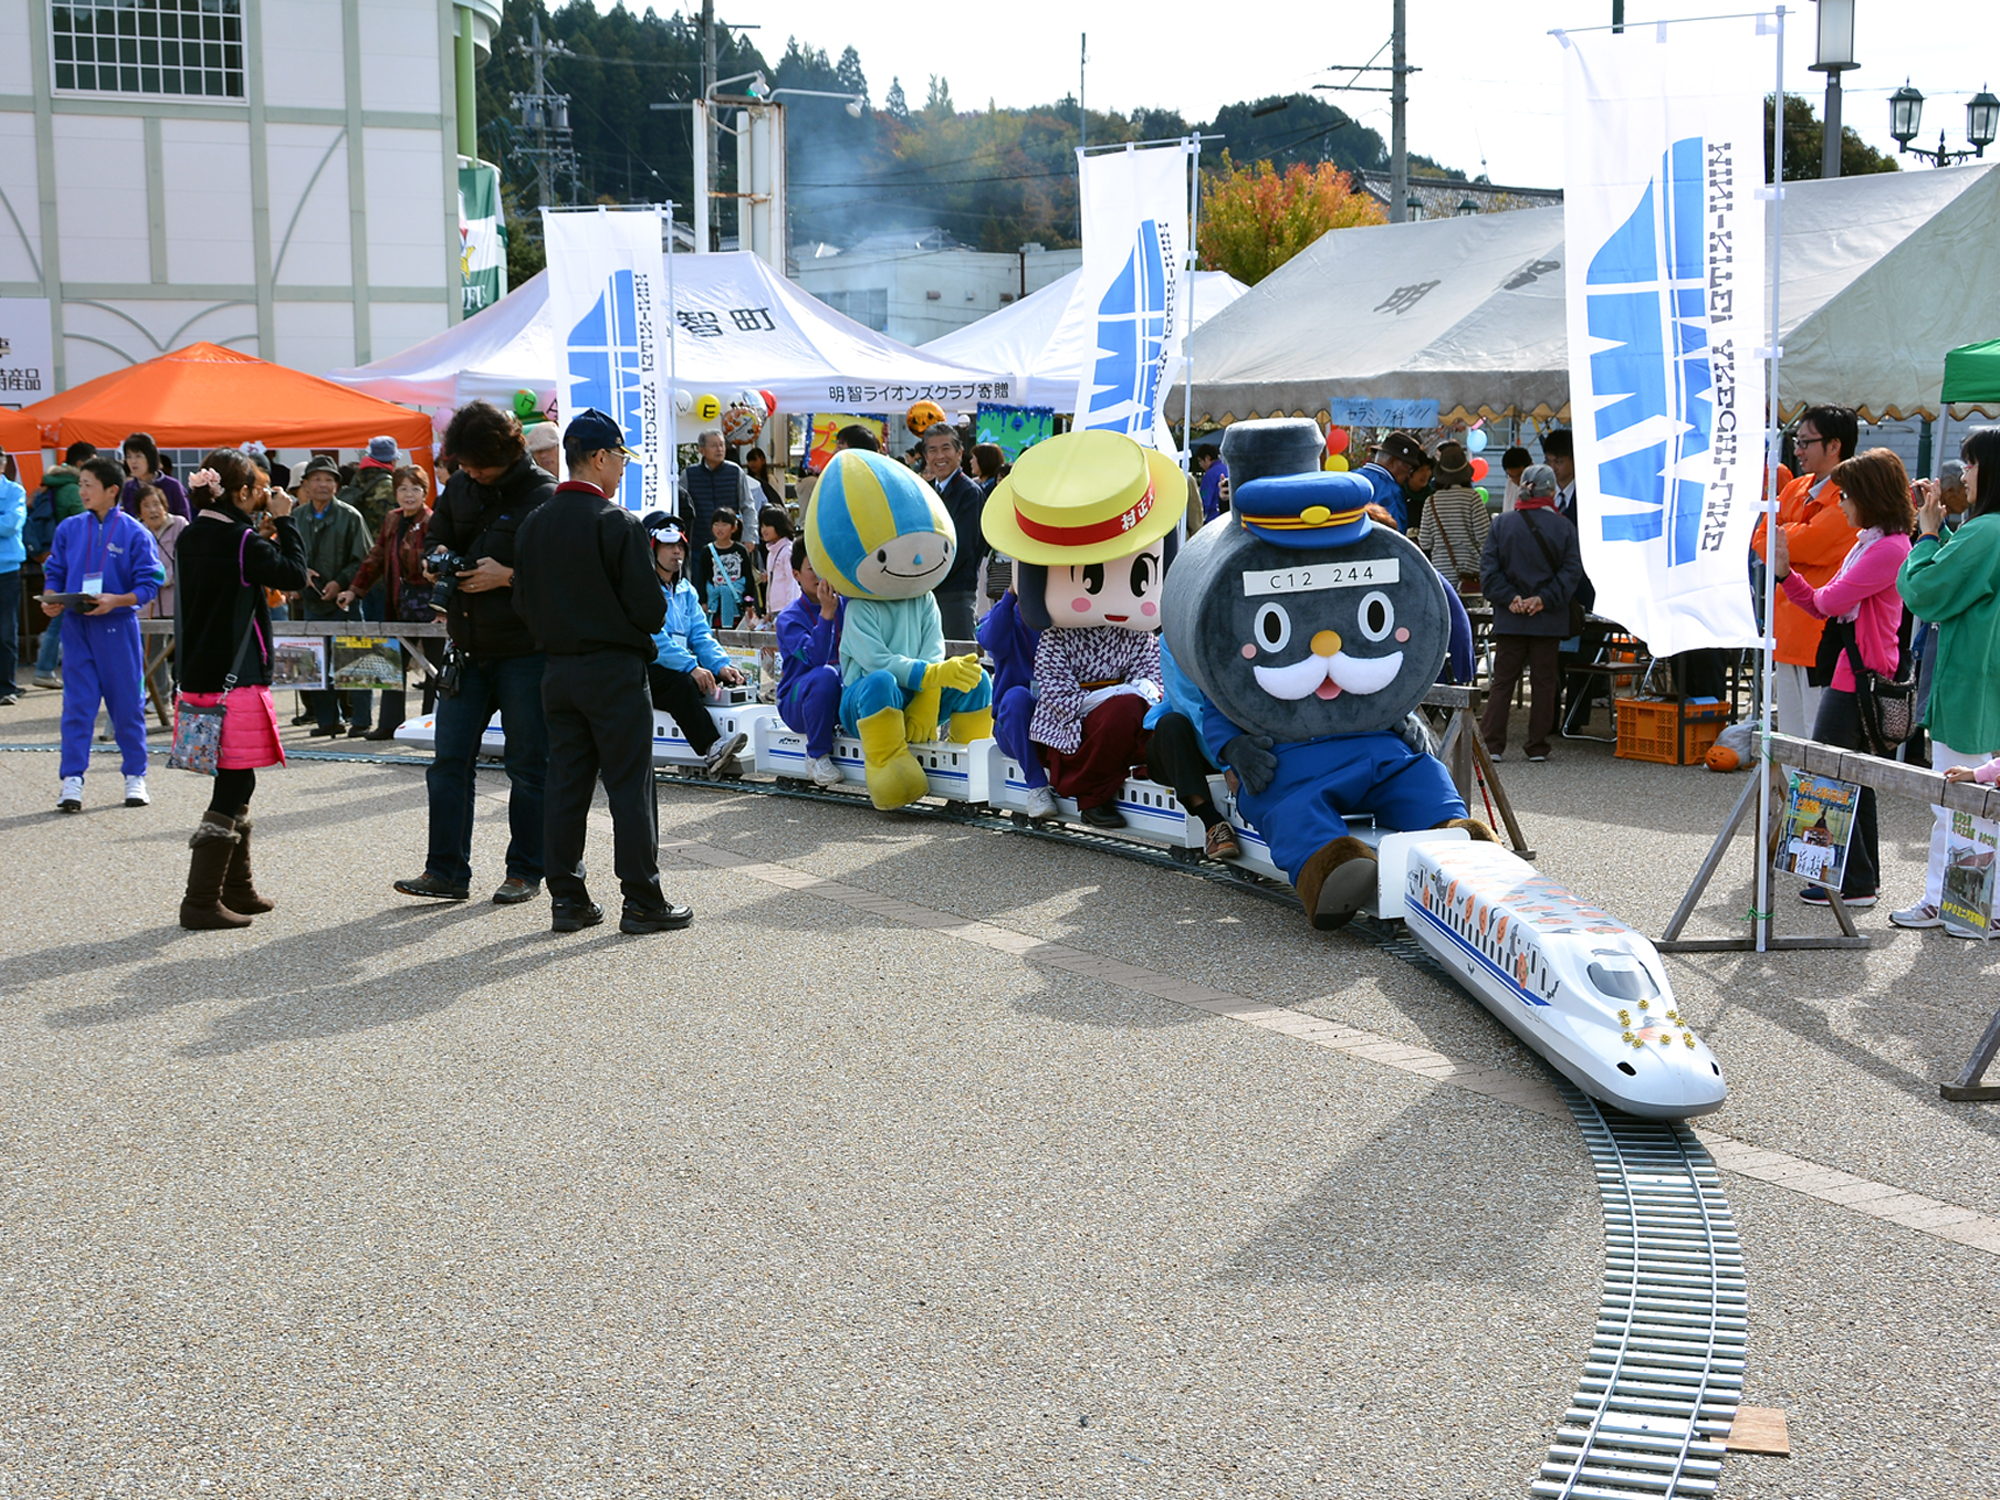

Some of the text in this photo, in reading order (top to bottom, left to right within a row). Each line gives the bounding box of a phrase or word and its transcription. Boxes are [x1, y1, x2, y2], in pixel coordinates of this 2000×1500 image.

[829, 382, 1009, 403] 明智ライオンズクラブ寄贈
[1270, 566, 1374, 589] C12 244
